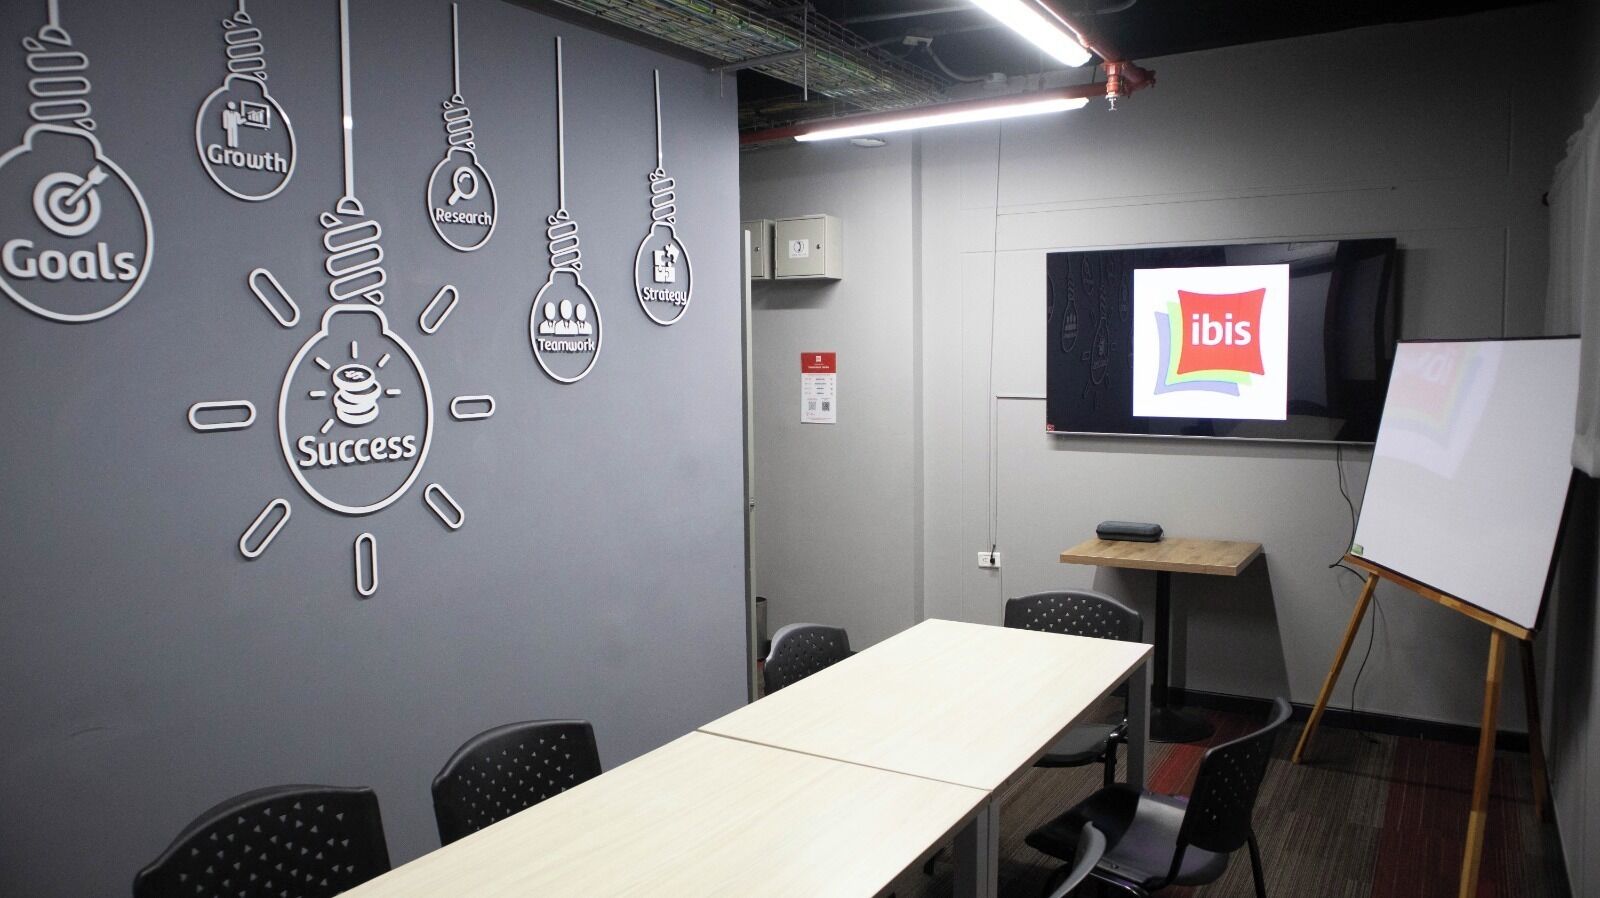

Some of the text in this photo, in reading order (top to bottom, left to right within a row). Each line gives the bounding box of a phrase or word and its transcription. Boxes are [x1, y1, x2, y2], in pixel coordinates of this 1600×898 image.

[207, 143, 287, 173] Growth
[435, 207, 492, 226] Research
[2, 239, 137, 281] Goals
[643, 286, 687, 306] Strategy
[538, 338, 595, 352] Teamwork
[1191, 313, 1252, 347] ibis
[298, 434, 417, 467] Success
